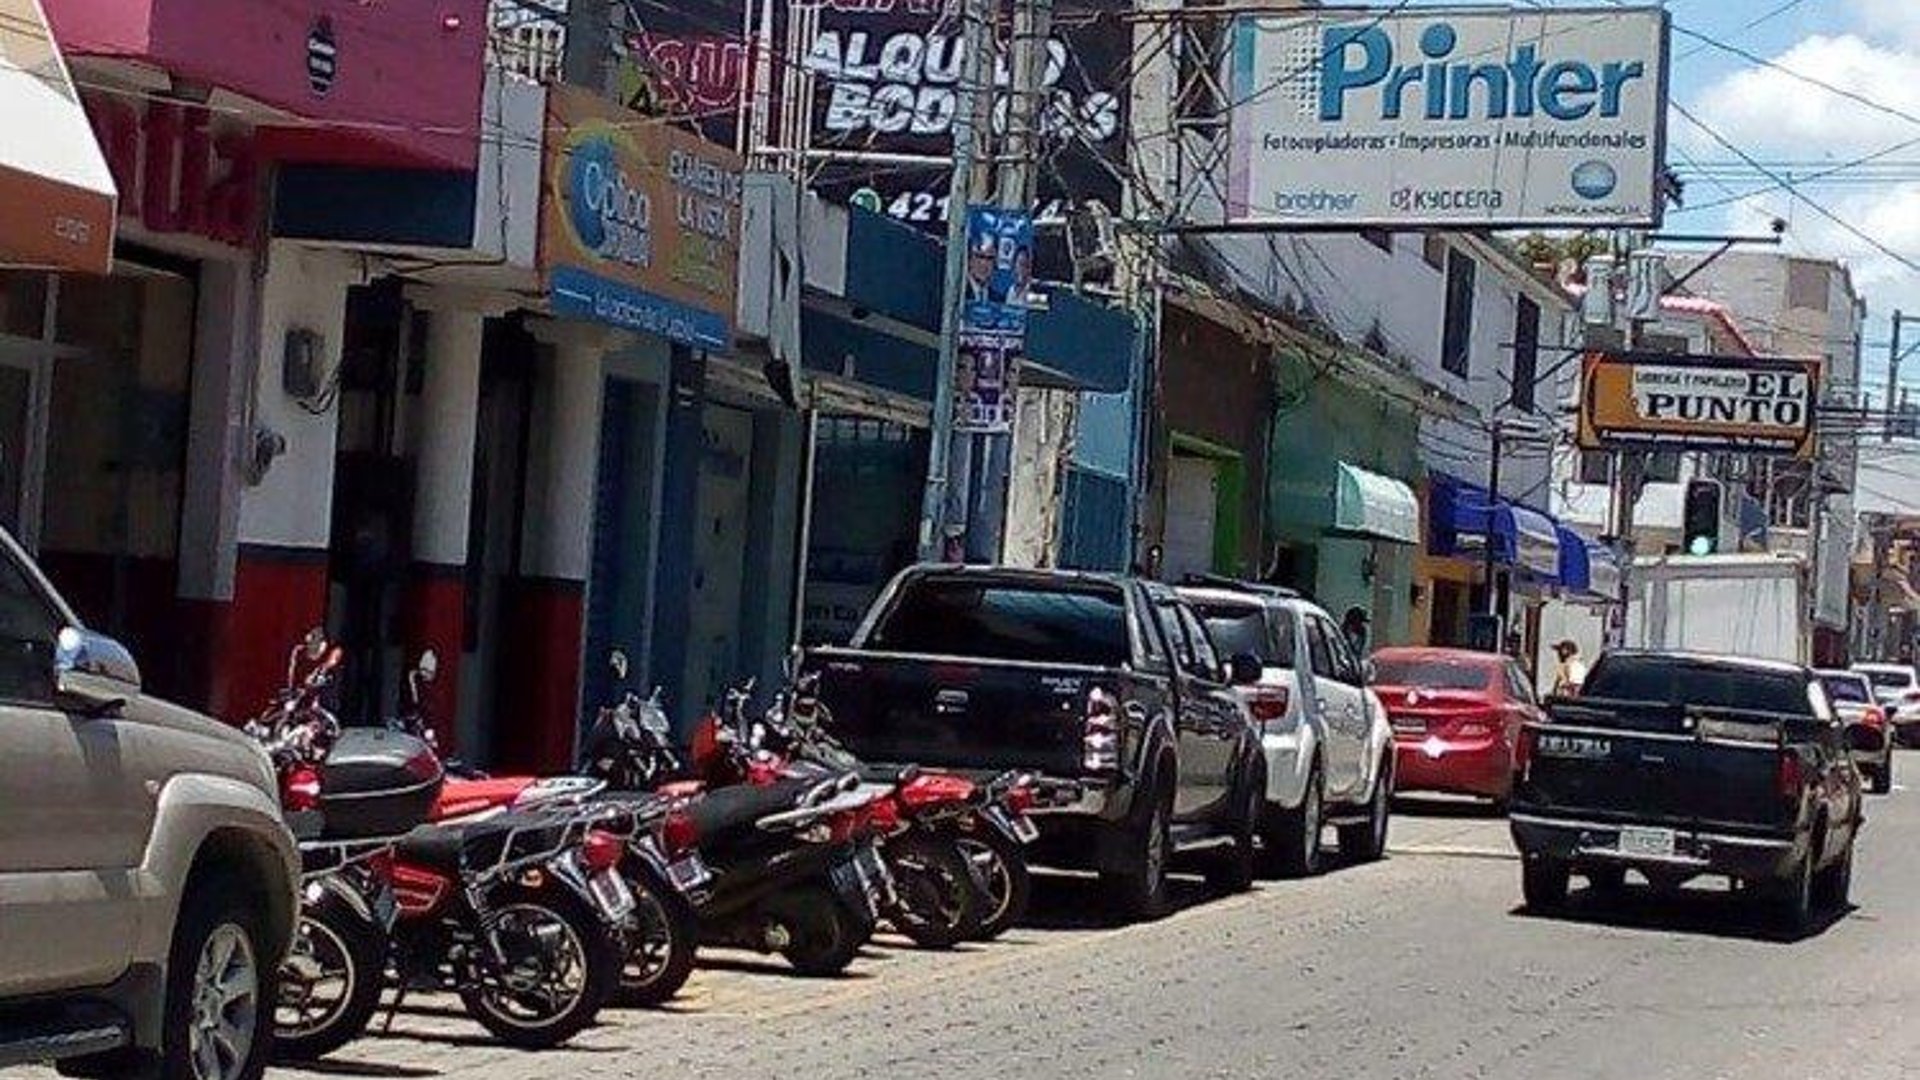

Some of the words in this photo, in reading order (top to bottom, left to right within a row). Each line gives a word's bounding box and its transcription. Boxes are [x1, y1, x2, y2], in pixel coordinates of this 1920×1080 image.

[800, 32, 1068, 86] ALQUO
[1319, 23, 1643, 121] Printer
[826, 83, 1118, 140] BODAS
[1263, 131, 1387, 153] Fotocopiadoras
[1399, 131, 1491, 153] Impresoras
[1504, 130, 1647, 149] Multifuncionales
[1415, 190, 1502, 209] KYOCERA
[1747, 373, 1803, 398] EL
[1647, 394, 1802, 425] PUNTO
